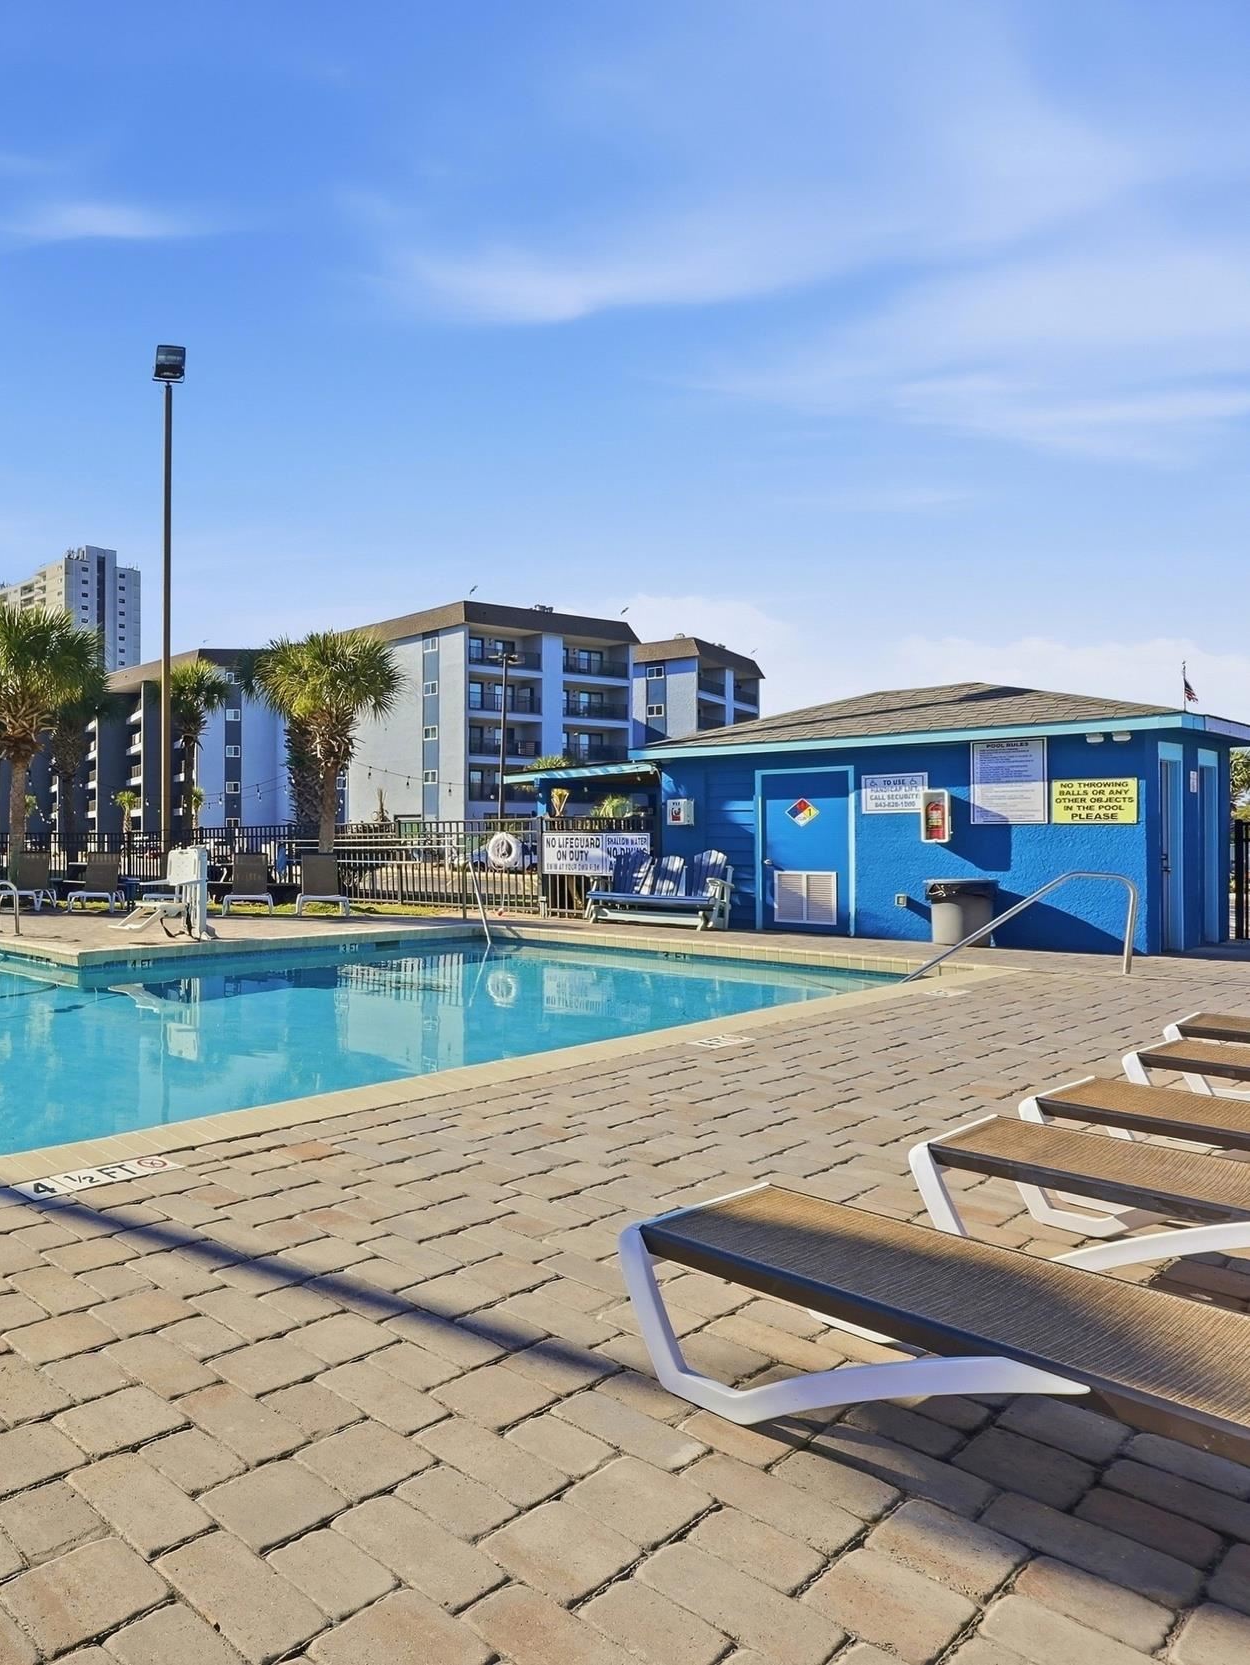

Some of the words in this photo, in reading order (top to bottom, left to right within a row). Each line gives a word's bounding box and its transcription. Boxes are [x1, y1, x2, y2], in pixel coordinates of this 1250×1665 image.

[546, 837, 557, 849] NO
[558, 837, 601, 849] LIFEGUARD
[607, 837, 630, 846] SHALLOW
[556, 850, 568, 861] ON
[569, 850, 590, 862] DUTY
[606, 847, 618, 858] NO
[33, 1181, 58, 1194] 4
[97, 1163, 137, 1179] FT
